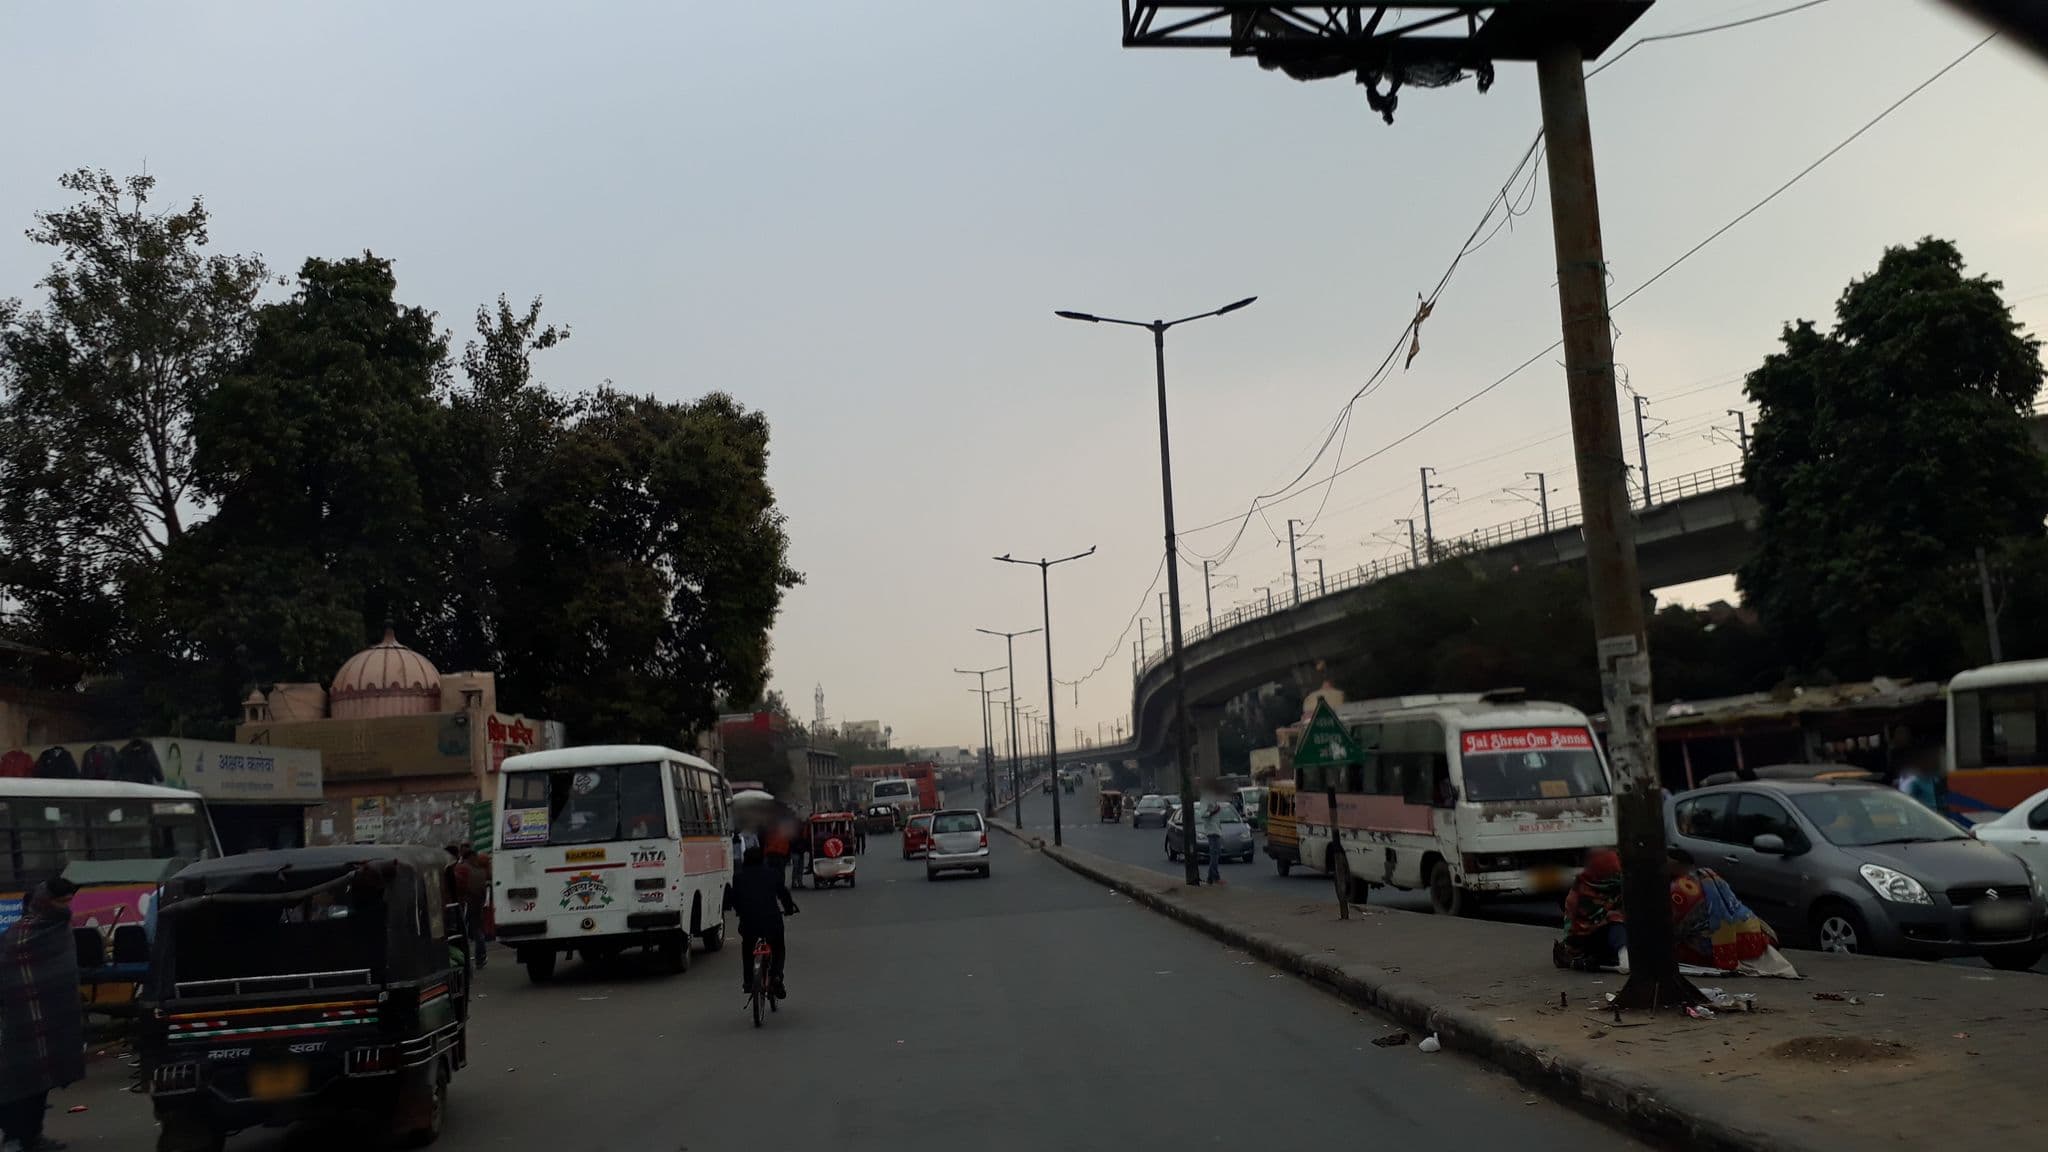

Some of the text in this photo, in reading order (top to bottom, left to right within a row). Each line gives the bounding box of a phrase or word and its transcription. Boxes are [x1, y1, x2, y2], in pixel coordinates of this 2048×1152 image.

[1466, 735, 1488, 752] Jai
[1490, 734, 1526, 749] Shree
[1526, 732, 1547, 747] Om
[630, 850, 666, 862] TATA
